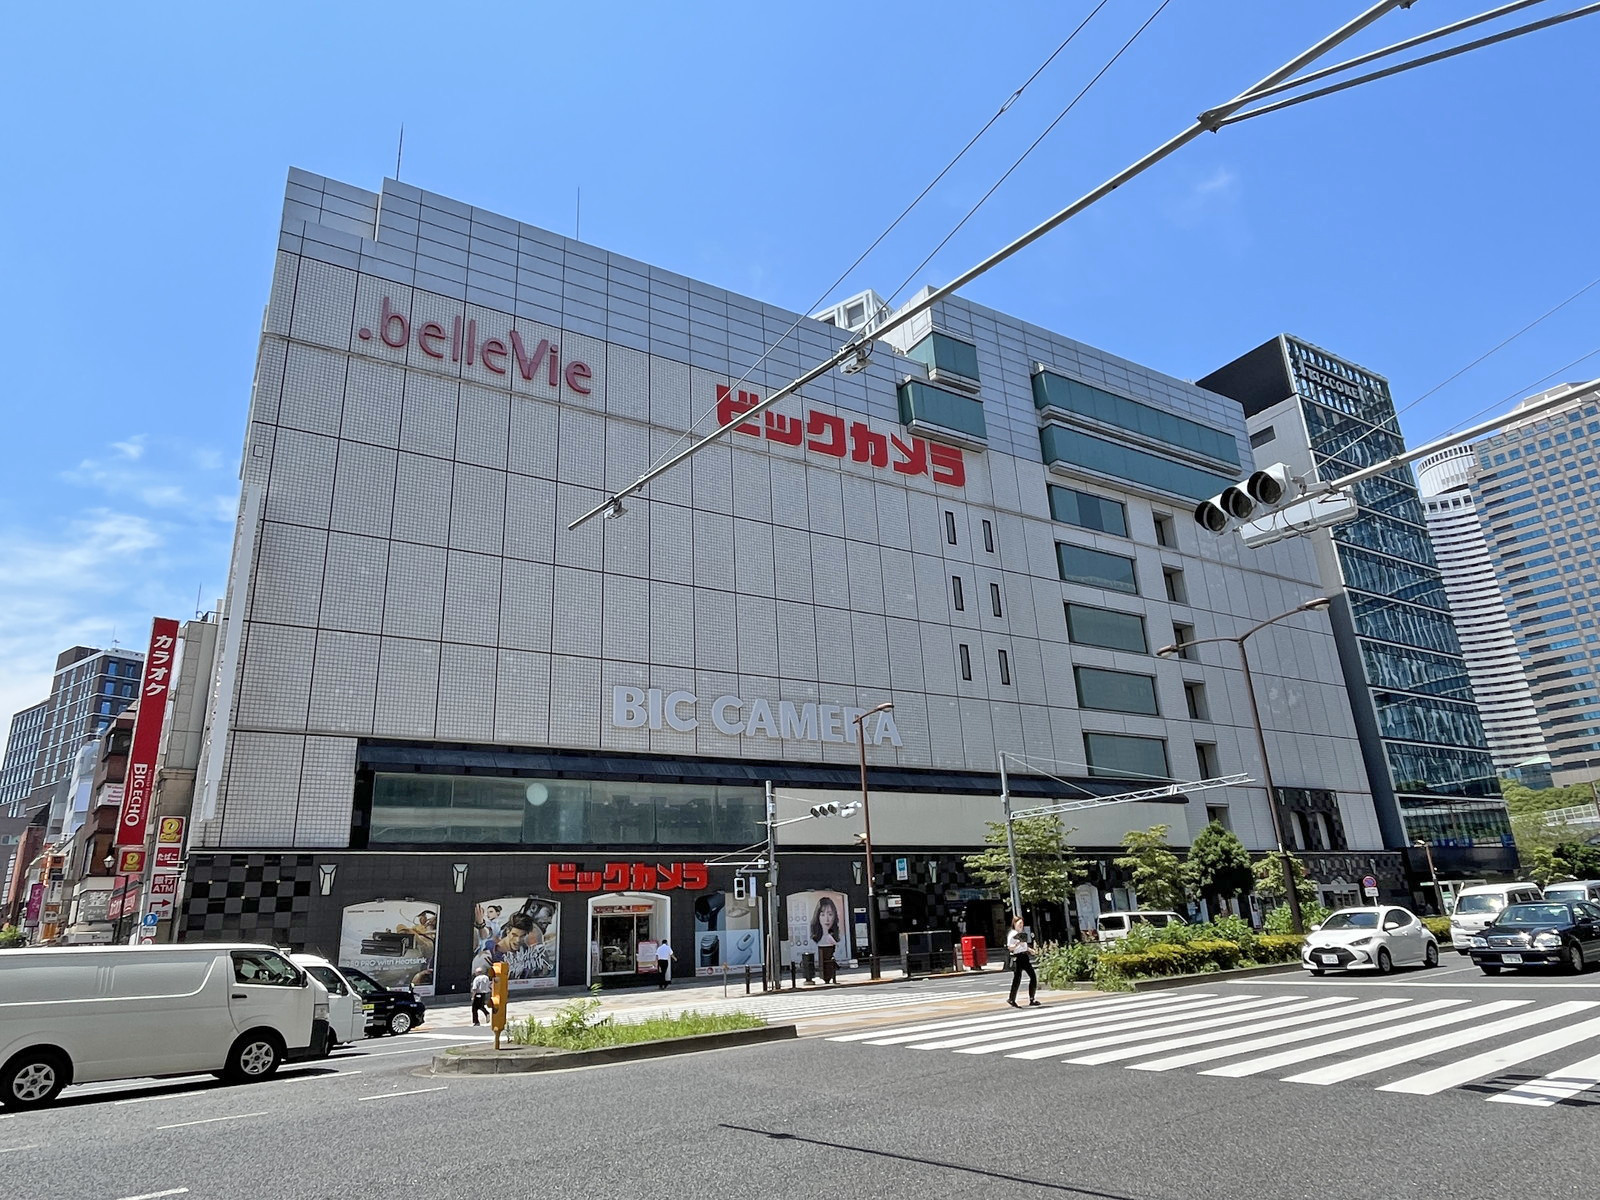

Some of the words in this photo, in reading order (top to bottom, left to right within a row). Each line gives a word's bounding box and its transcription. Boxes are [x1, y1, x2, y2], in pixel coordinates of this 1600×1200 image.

[716, 384, 966, 487] ビックカメラ
[145, 634, 174, 697] カラオケ
[612, 685, 698, 732] BIC
[712, 695, 902, 747] CAMERA
[133, 763, 148, 788] BIG
[124, 791, 143, 827] ECHO
[157, 852, 177, 861] たばこ
[153, 884, 174, 893] ATM
[154, 875, 174, 885] 銀行
[548, 861, 709, 893] ビックカメラ
[378, 959, 394, 967] with
[395, 956, 427, 966] Heatsink
